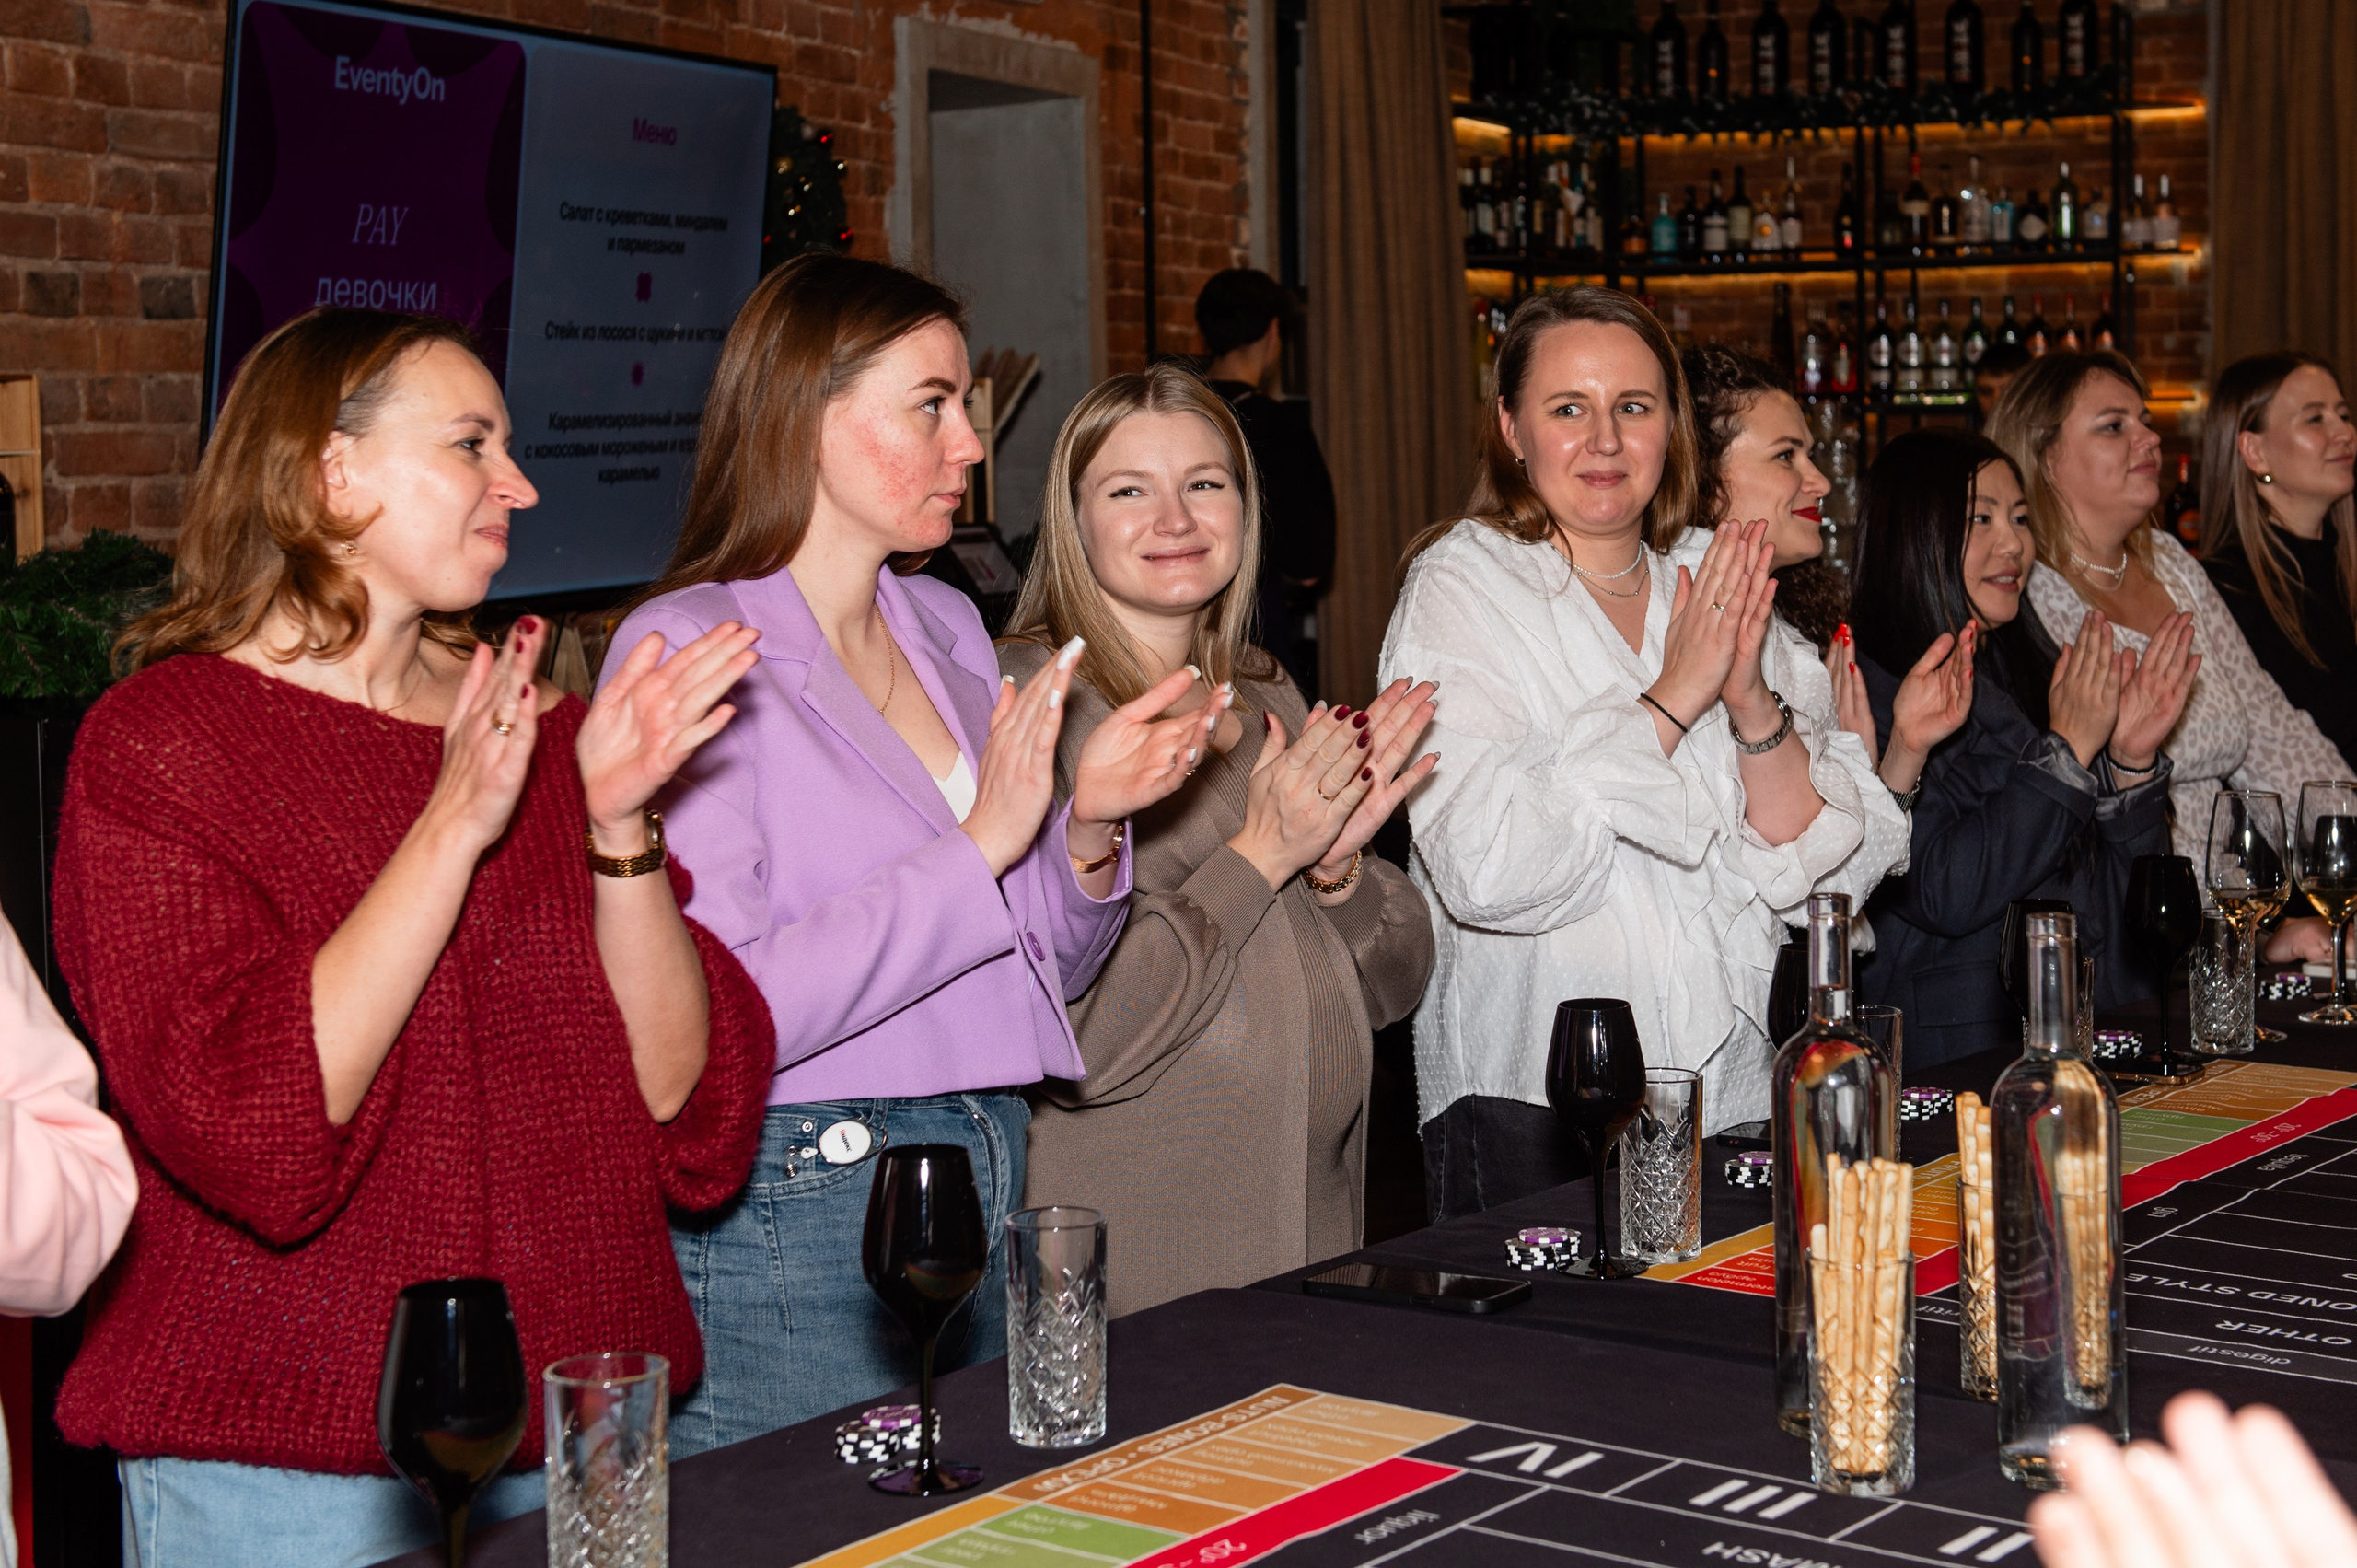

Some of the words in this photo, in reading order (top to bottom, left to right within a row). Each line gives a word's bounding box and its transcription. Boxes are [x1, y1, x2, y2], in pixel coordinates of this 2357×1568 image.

[334, 54, 447, 105] EventyOn
[632, 117, 679, 146] Меню
[559, 201, 596, 222] Салат
[597, 208, 604, 222] с
[351, 203, 410, 246] PAY
[607, 237, 616, 251] и
[617, 238, 685, 257] пармезаном
[315, 276, 438, 310] девочки
[545, 320, 579, 340] Стейк
[582, 325, 595, 340] из
[598, 326, 637, 340] лосося
[639, 326, 645, 340] с
[525, 445, 531, 459] с
[535, 443, 599, 458] кокосовым
[601, 440, 668, 458] мороженым
[598, 466, 660, 485] карамелью
[2256, 1152, 2310, 1172] tequila
[2146, 1206, 2179, 1219] gin
[1736, 1260, 1771, 1271] fruit
[1697, 1275, 1776, 1292] atermelon
[2124, 1272, 2242, 1295] STYLE
[1914, 1305, 1961, 1316] ritif
[2247, 1290, 2357, 1312] ONED
[2213, 1319, 2353, 1346] OTHER
[2186, 1344, 2292, 1366] digestif
[1466, 1440, 1604, 1479] IV
[1688, 1478, 1817, 1520] III
[1353, 1509, 1441, 1545] liquor
[1701, 1541, 1843, 1568] MASH
